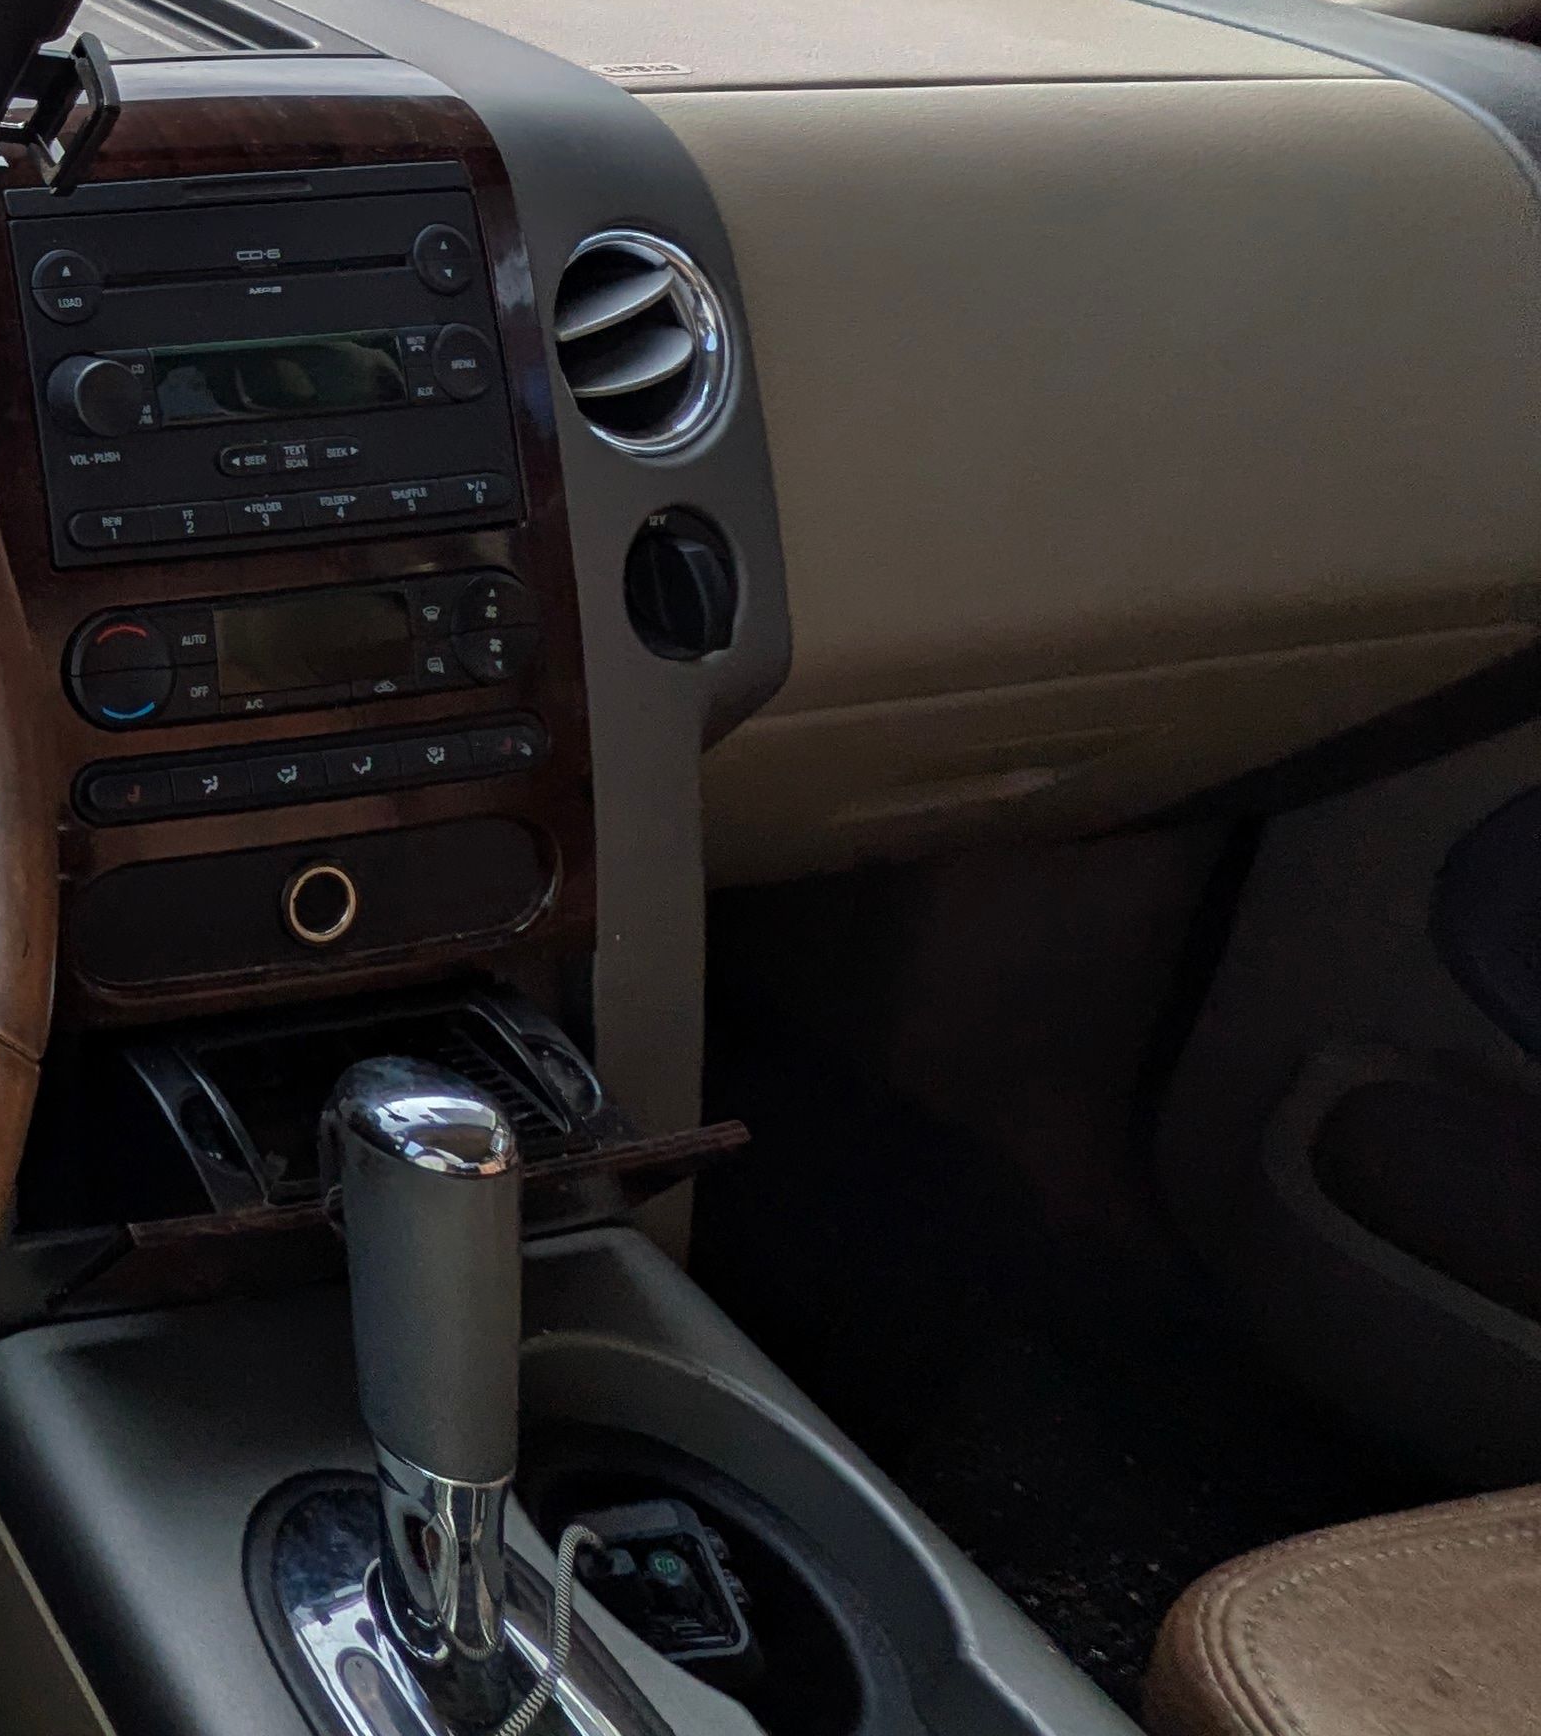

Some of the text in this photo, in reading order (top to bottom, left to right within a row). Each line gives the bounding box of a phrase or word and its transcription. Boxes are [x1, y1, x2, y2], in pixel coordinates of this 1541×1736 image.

[58, 298, 83, 309] LOAD
[131, 364, 145, 375] CD
[451, 359, 477, 369] MENU
[417, 386, 434, 397] AUX
[283, 444, 307, 456] TEXT
[326, 447, 349, 458] SEEK
[244, 454, 267, 466] SEEK
[285, 458, 309, 469] SCAN
[320, 495, 350, 507] FOLDER
[476, 491, 484, 503] 6
[251, 502, 282, 513] FOLDER
[407, 500, 417, 512] 5
[336, 507, 345, 519] 4
[102, 517, 122, 528] REW
[262, 514, 270, 527] 3
[186, 521, 195, 534] 2
[111, 528, 118, 540] 1
[181, 634, 207, 646] AUTO
[190, 686, 210, 698] OFF
[245, 699, 264, 710] A/C
